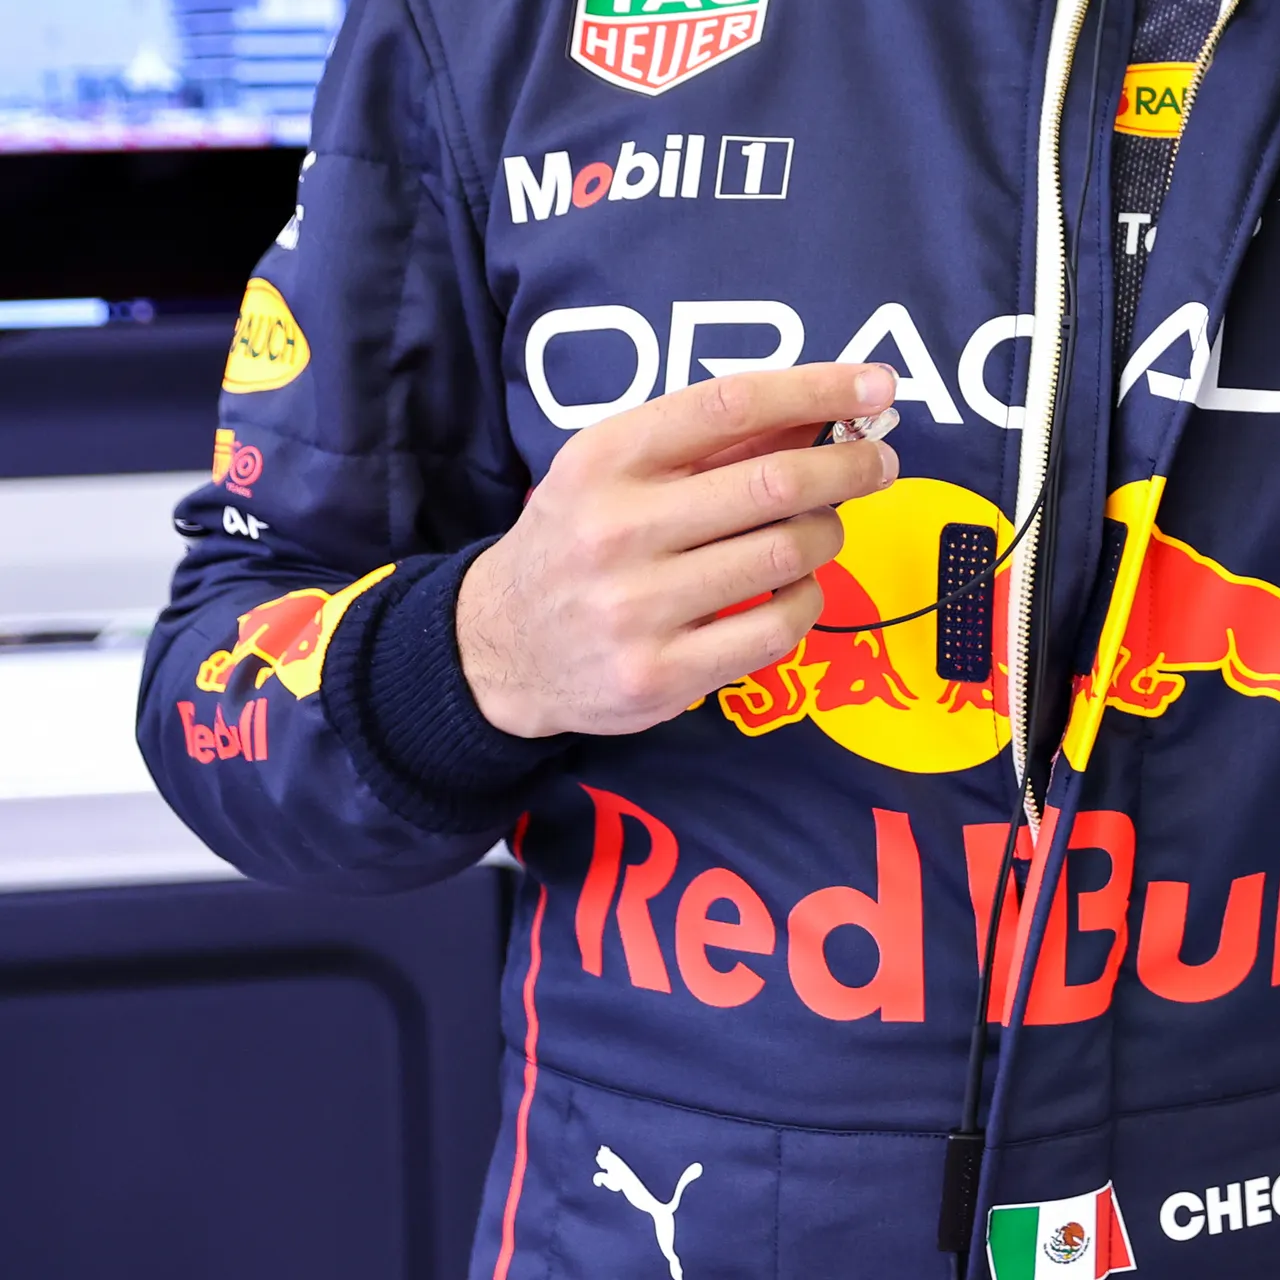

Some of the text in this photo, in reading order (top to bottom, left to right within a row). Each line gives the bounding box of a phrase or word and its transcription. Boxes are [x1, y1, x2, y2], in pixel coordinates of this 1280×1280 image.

[585, 19, 751, 88] HEUER
[503, 134, 706, 224] Mobil
[574, 781, 925, 1023] Red
